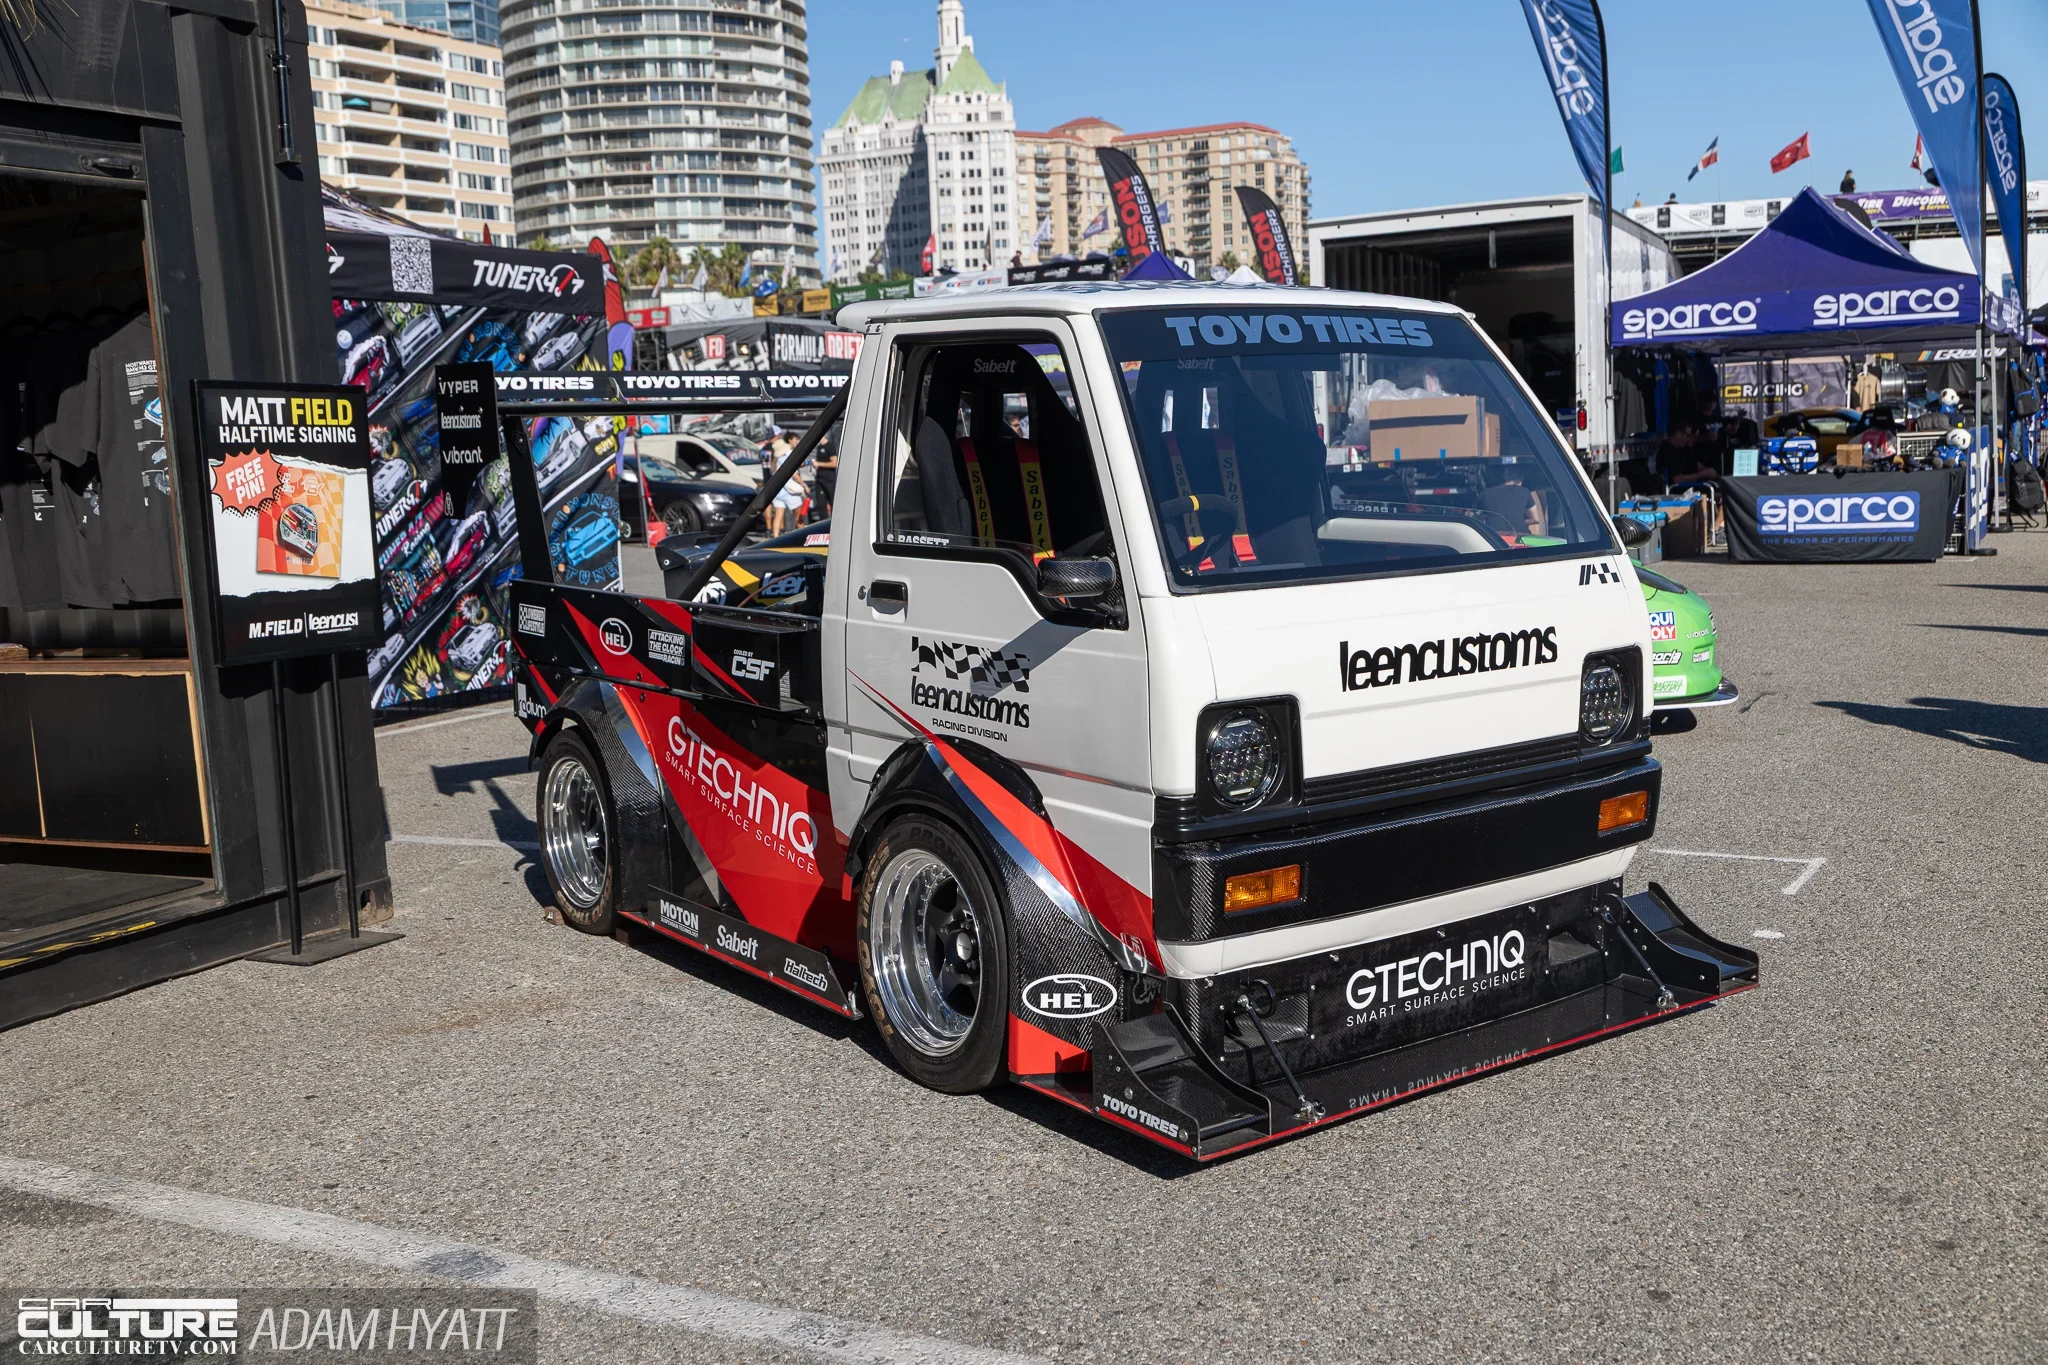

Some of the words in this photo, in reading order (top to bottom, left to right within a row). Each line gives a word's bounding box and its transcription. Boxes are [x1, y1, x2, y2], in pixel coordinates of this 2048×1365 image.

[1813, 285, 1960, 327] sparco
[1164, 314, 1303, 347] TOYO
[1302, 315, 1433, 348] TIRES
[1622, 300, 1757, 339] sparco
[774, 334, 825, 363] FORMULA
[974, 358, 1018, 374] Sabelt
[439, 379, 479, 395] VYPER
[495, 376, 527, 391] YO
[529, 376, 594, 391] TIRES
[624, 375, 680, 389] TOYO
[681, 375, 741, 389] TIRES
[767, 375, 819, 388] TOYO
[820, 375, 850, 388] TIR
[220, 396, 286, 425] MATT
[290, 398, 353, 426] FIELD
[441, 411, 482, 430] leencustoms
[219, 426, 296, 443] HALFTIME
[299, 426, 357, 444] SIGNING
[442, 446, 484, 465] vibrant
[225, 456, 264, 491] FREE
[236, 478, 265, 505] PIN!
[1176, 463, 1197, 537] Sablt
[1026, 470, 1048, 548] Sabelt
[1761, 494, 1916, 533] sparco
[1783, 537, 1818, 545] POWER
[1838, 535, 1915, 544] PERFORMANCE
[249, 618, 303, 639] M.FIELD
[1650, 611, 1675, 626] QUI
[605, 632, 627, 648] HEL
[650, 631, 684, 646] ATTACKING
[1652, 626, 1676, 640] OLY
[650, 641, 661, 651] THE
[662, 643, 684, 655] CLOCK
[1339, 626, 1558, 693] leencustoms
[732, 655, 775, 681] CSF
[911, 675, 1030, 728] leencustoms
[932, 717, 966, 733] RACING
[968, 727, 1008, 742] DIVISION
[665, 751, 696, 786] SMART
[700, 785, 749, 832] SURFACE
[755, 829, 814, 875] SCIENCE
[660, 899, 698, 930] MOTON
[716, 925, 758, 960] Sabelt
[784, 958, 828, 991] Haltech
[1040, 993, 1101, 1009] HEL
[1346, 1004, 1396, 1026] SMART
[1404, 986, 1466, 1012] SURFACE
[1472, 968, 1525, 993] SCIENCE
[1103, 1094, 1137, 1119] TOYO
[1138, 1109, 1179, 1138] TIRES
